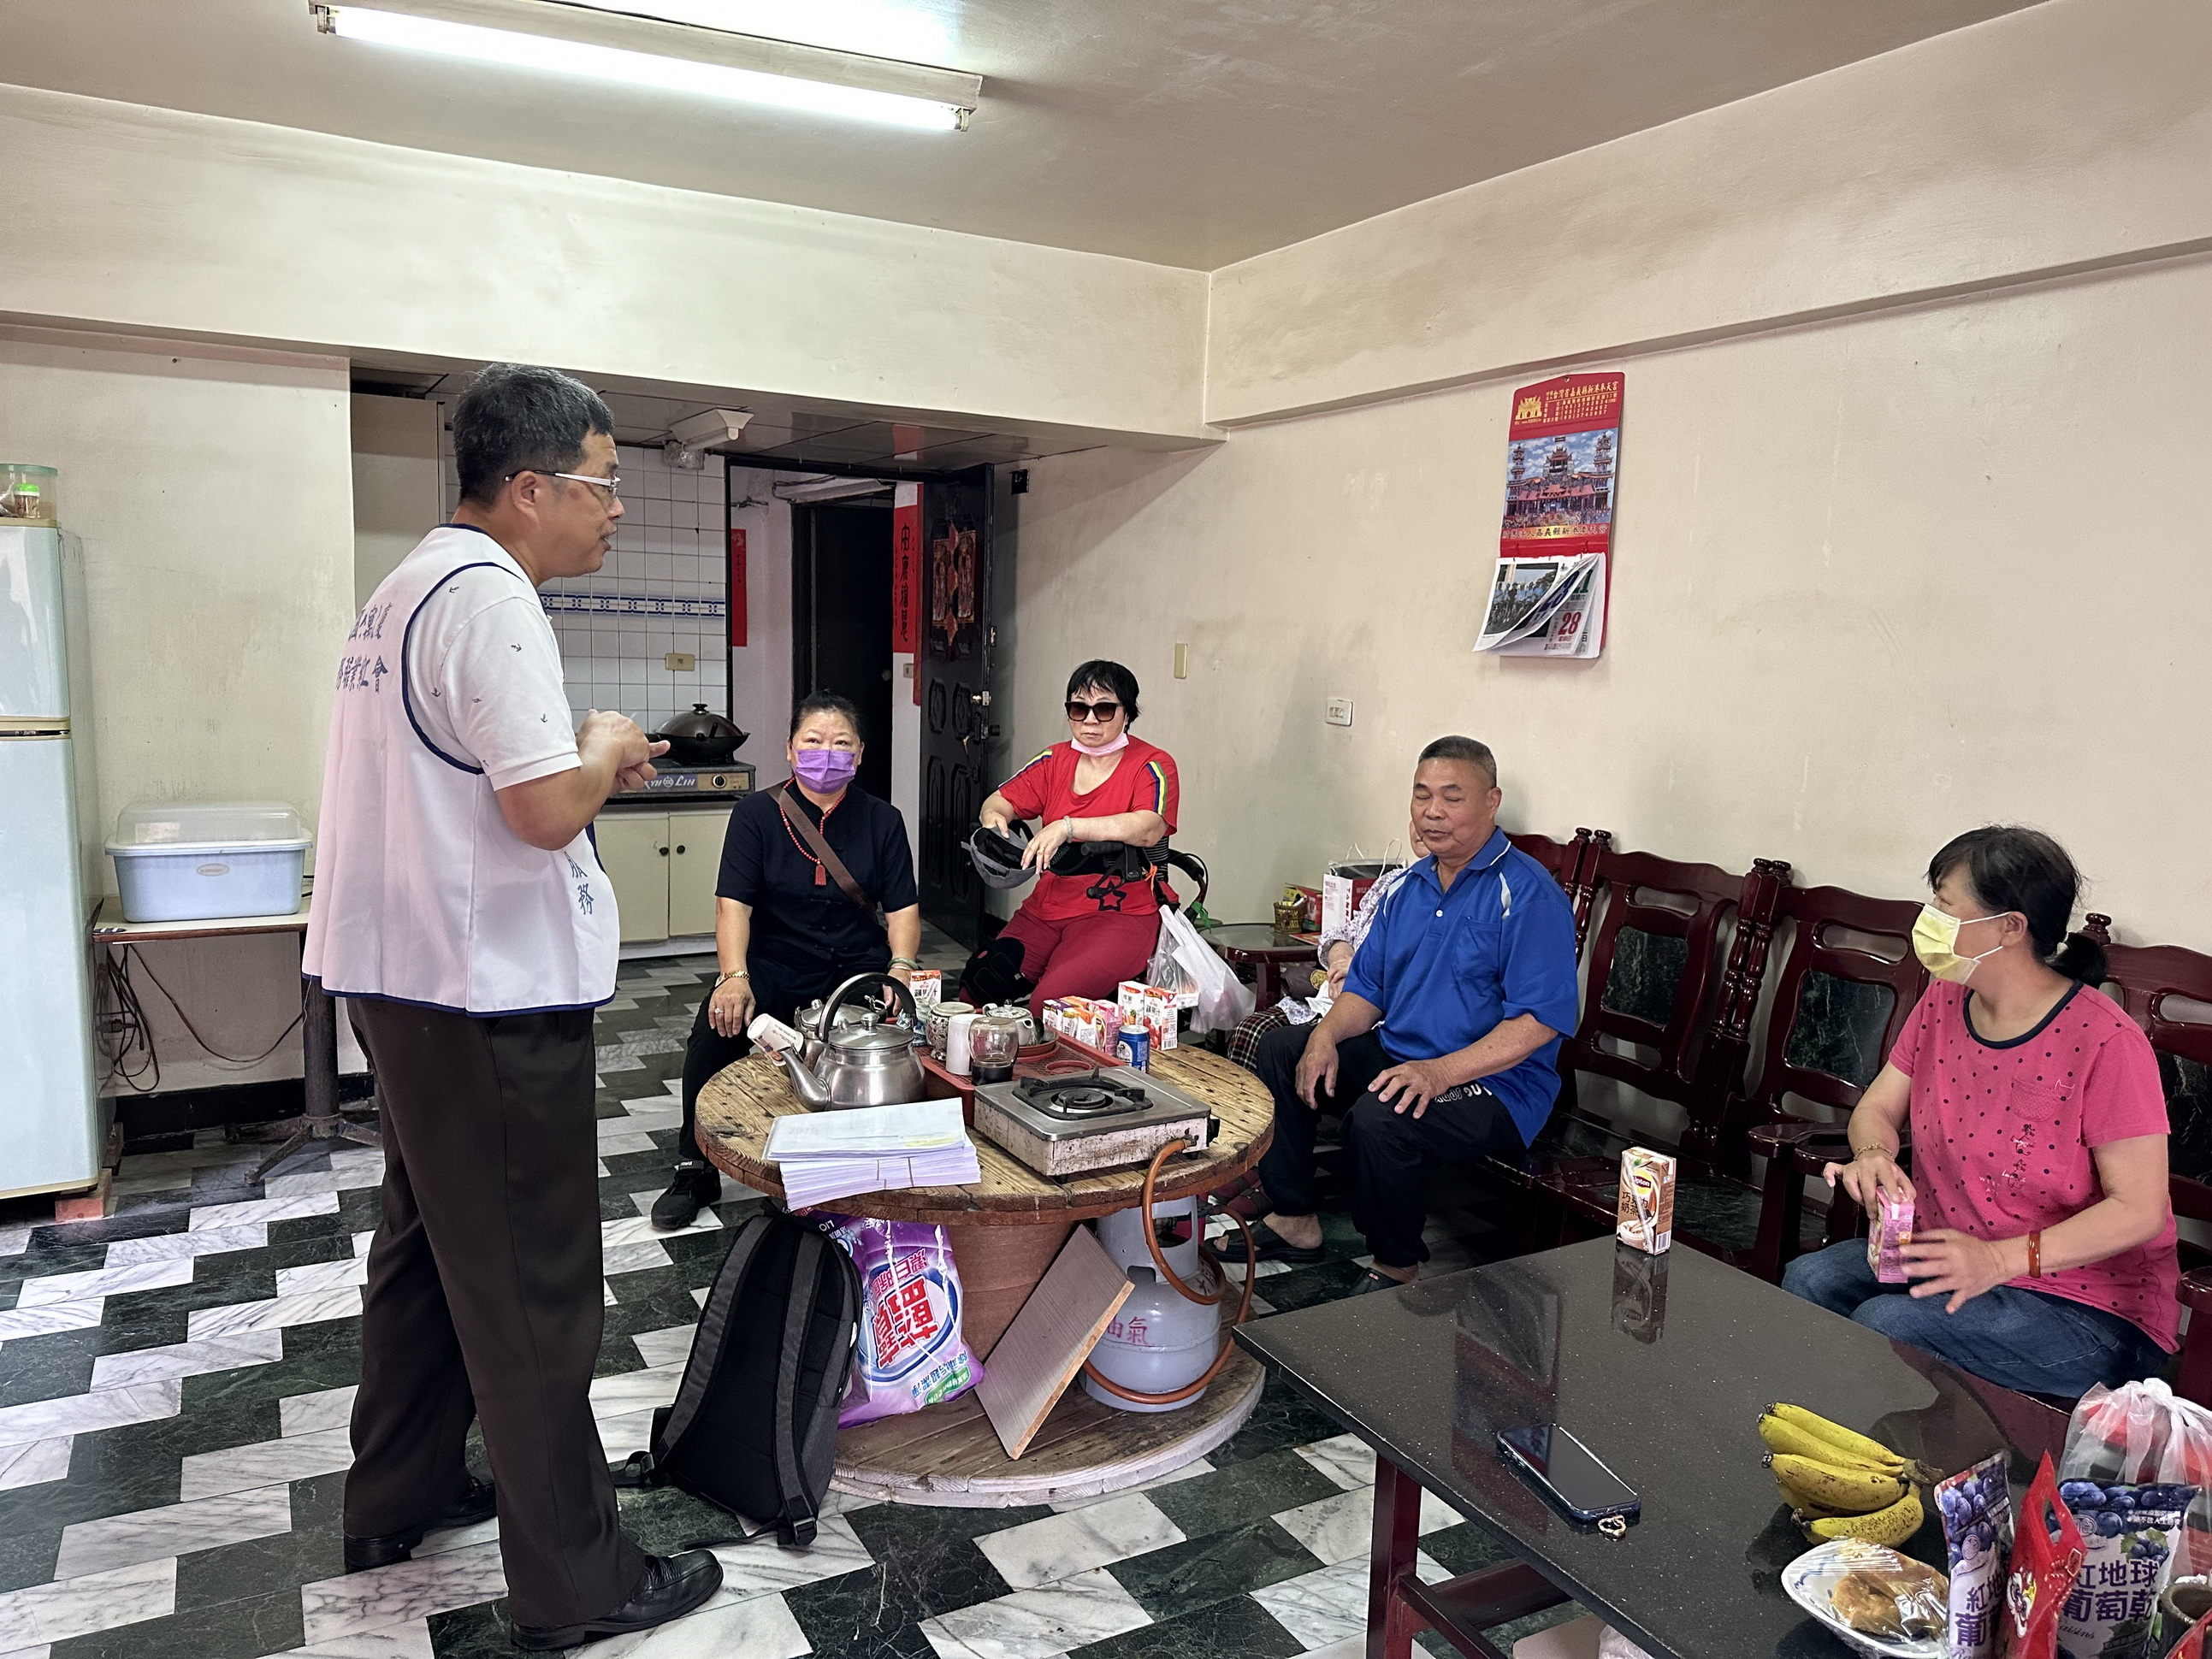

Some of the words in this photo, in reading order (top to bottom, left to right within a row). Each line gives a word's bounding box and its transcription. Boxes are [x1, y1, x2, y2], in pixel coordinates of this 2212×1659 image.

[1558, 611, 1582, 635] 28
[1621, 1201, 1638, 1216] 奶茶
[819, 1219, 835, 1231] LIO
[1967, 1570, 2002, 1612] 紅地
[2063, 1589, 2156, 1622] 葡萄乾
[2058, 1624, 2095, 1639] aisins
